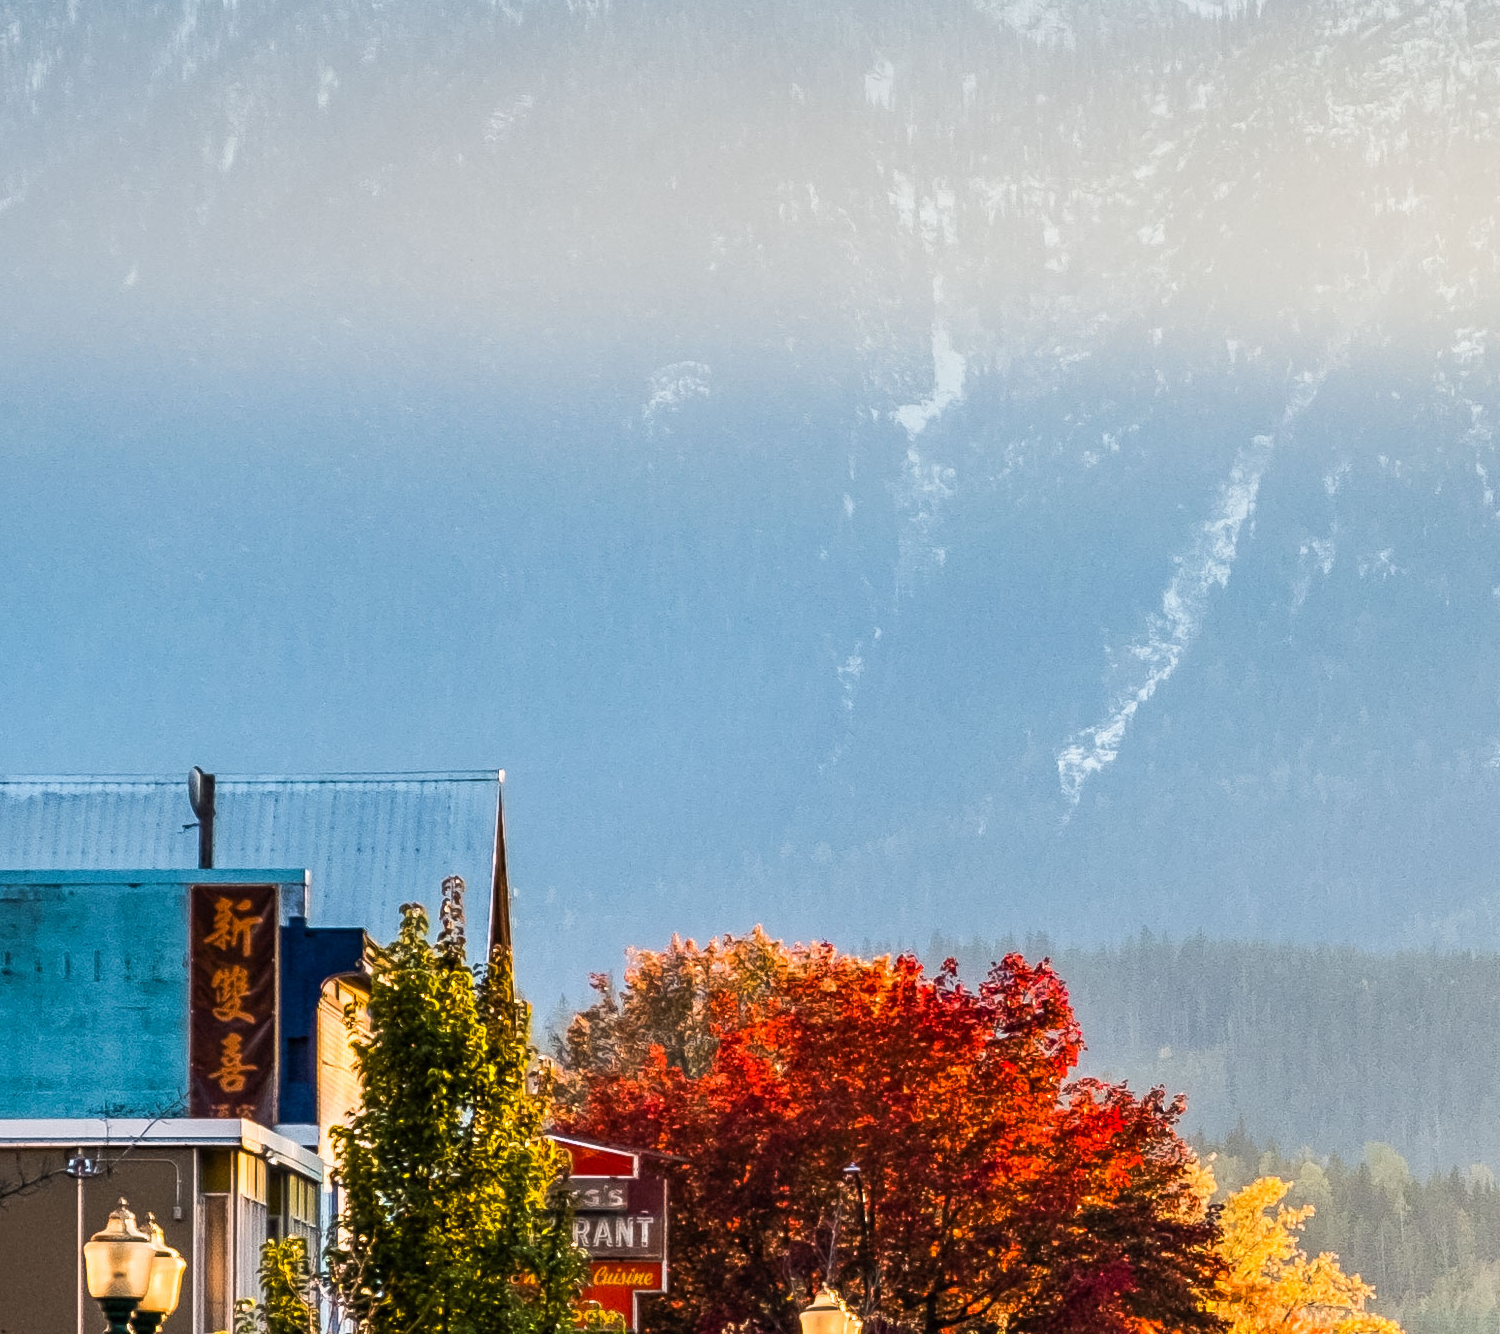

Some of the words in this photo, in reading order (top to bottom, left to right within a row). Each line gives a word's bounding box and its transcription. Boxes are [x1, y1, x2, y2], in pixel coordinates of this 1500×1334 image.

[202, 897, 264, 1093] 新雙喜
[593, 1266, 654, 1286] Cuisine
